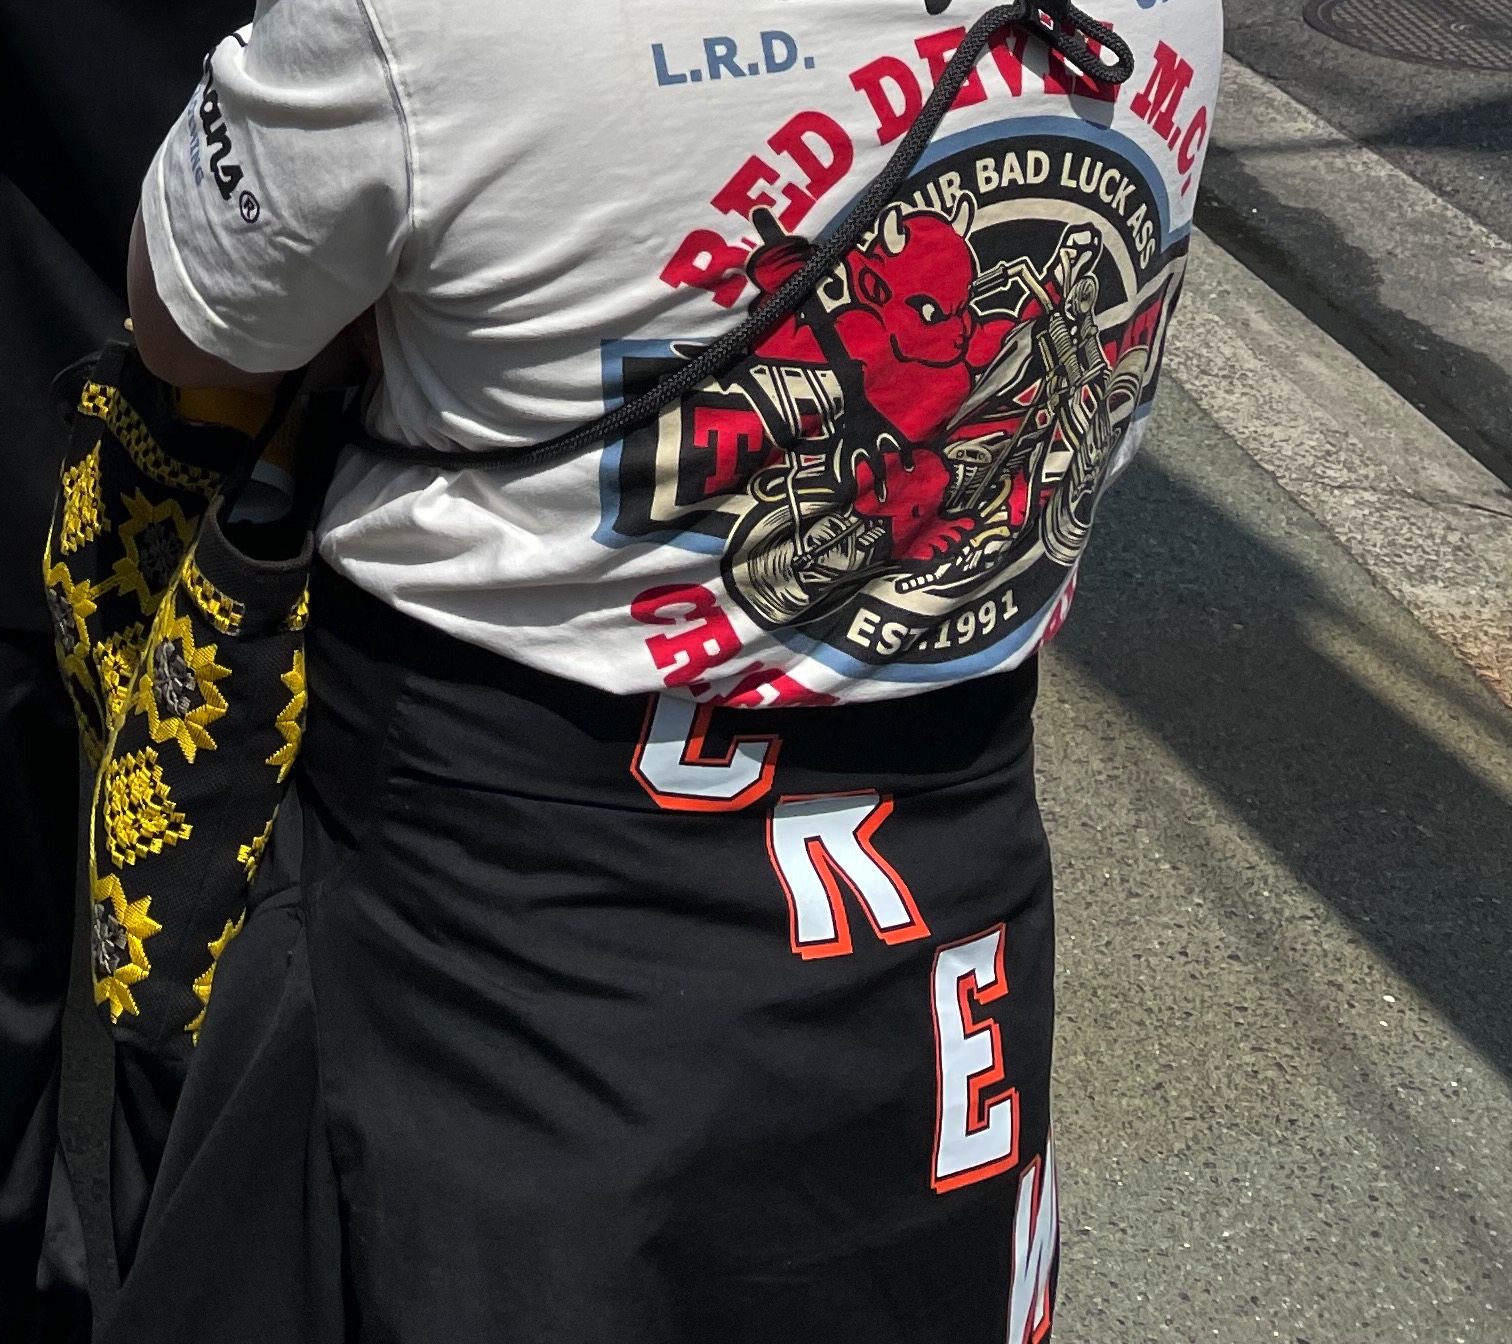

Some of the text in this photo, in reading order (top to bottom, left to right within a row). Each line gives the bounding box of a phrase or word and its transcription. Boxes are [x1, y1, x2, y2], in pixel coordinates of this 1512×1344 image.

[651, 29, 816, 87] L.R.D.
[659, 111, 854, 309] RED
[1130, 40, 1207, 198] M.C.
[975, 150, 1050, 194] BAD
[1060, 152, 1136, 212] LUCK
[1127, 203, 1156, 270] ASS
